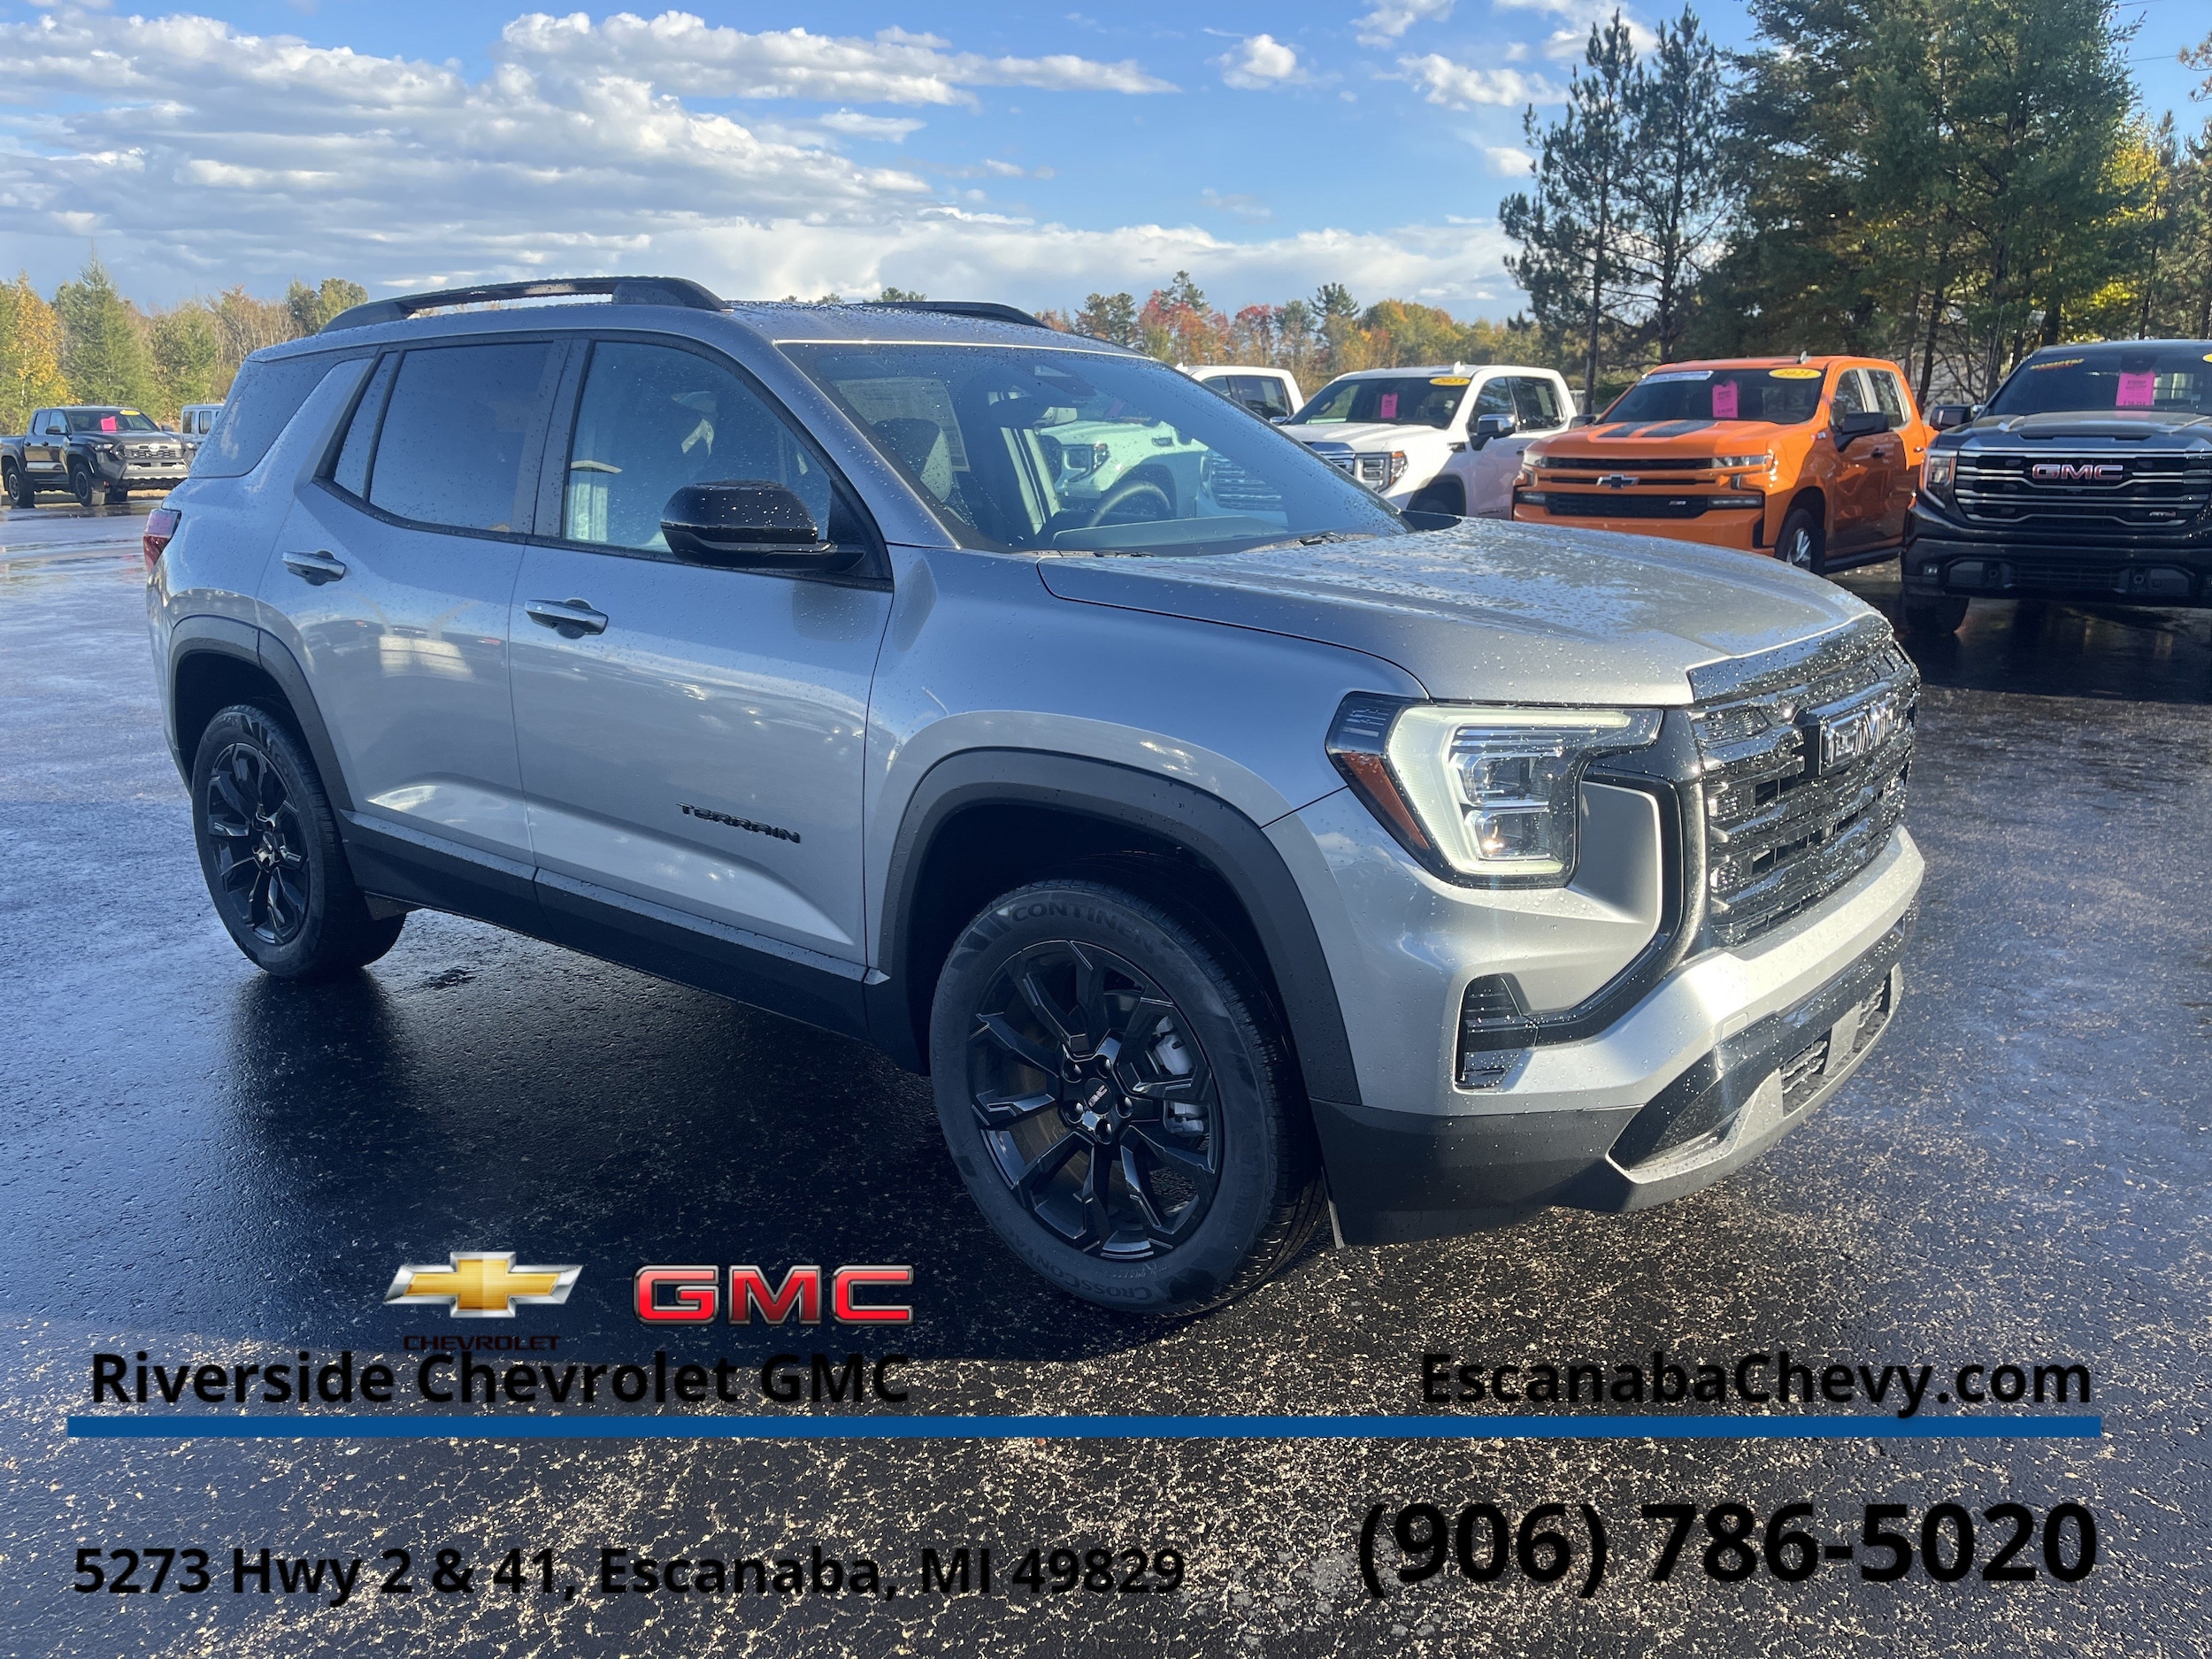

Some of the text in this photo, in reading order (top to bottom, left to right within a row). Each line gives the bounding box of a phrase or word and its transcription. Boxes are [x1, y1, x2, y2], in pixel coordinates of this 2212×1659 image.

[2032, 464, 2124, 480] GMC
[676, 802, 801, 843] TERRAIN
[1088, 1085, 1108, 1107] GMC
